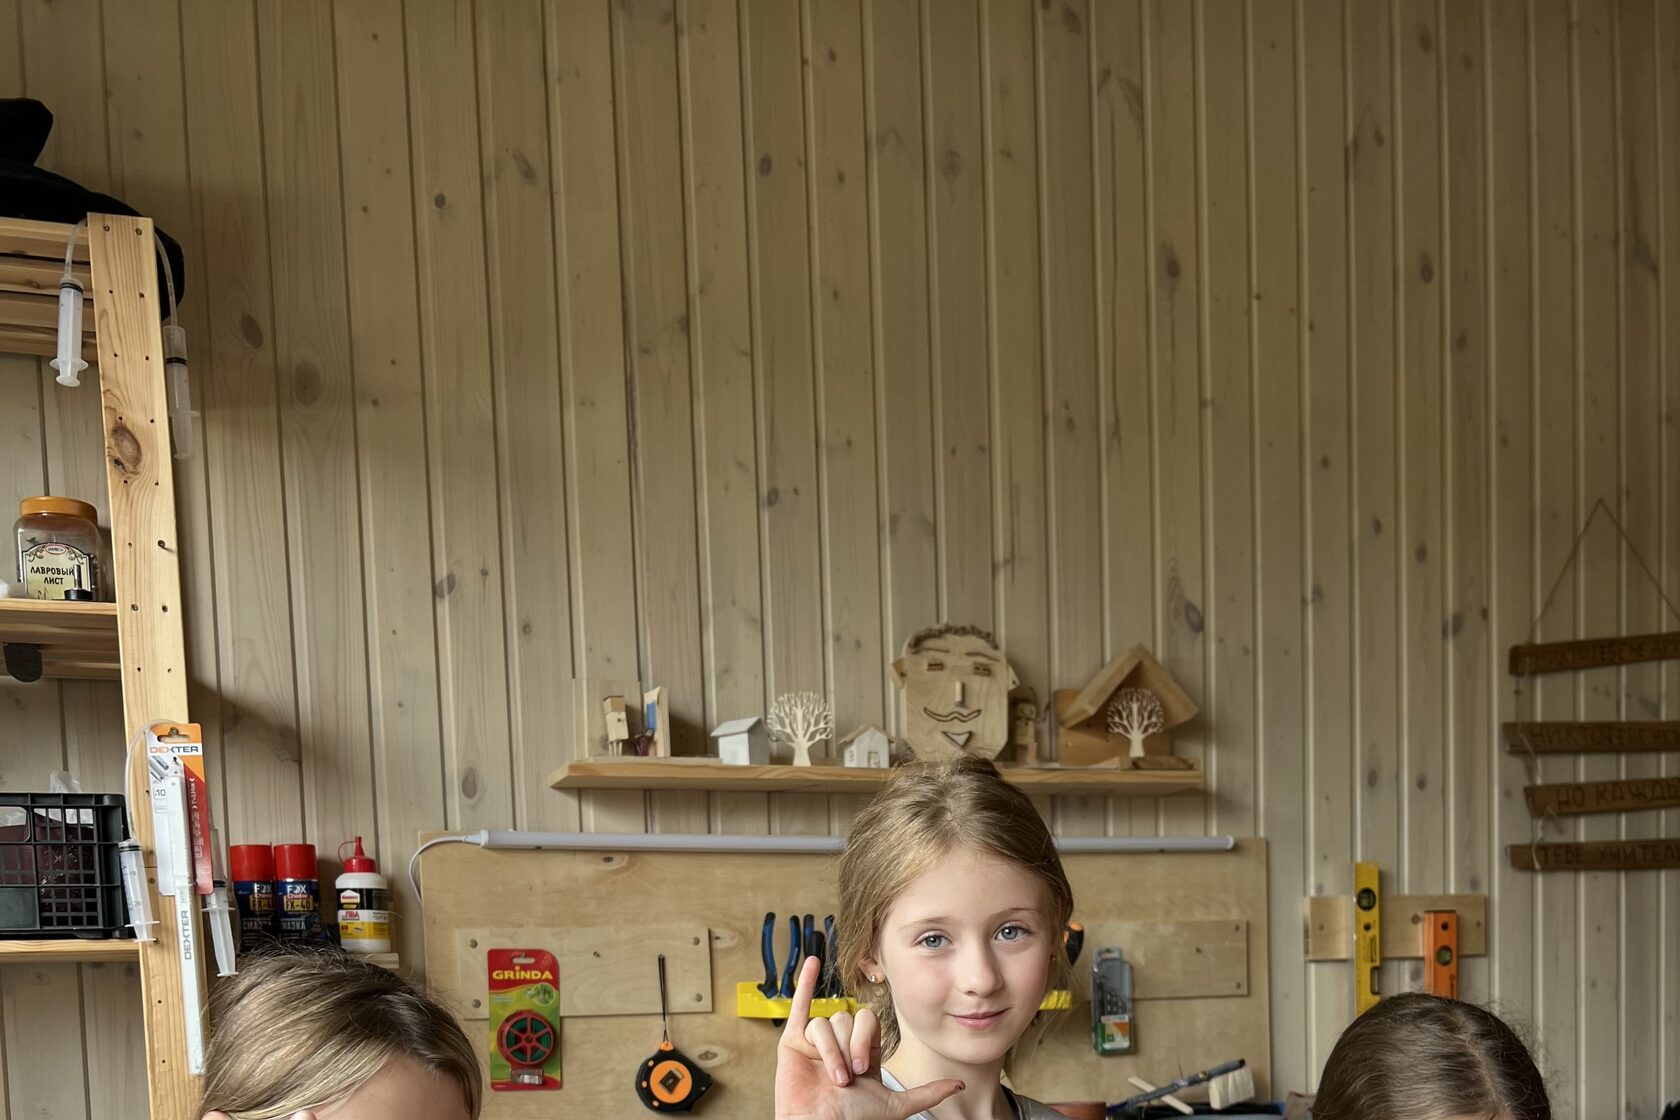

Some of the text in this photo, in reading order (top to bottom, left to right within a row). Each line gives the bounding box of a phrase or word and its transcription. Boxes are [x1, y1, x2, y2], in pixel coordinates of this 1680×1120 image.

[30, 566, 74, 576] ЛАВРОВЫЙ
[44, 577, 64, 585] ЛИСТ
[150, 745, 199, 754] DEXTER
[1555, 785, 1584, 811] НО
[286, 900, 311, 909] FX-40
[243, 921, 271, 931] СМАЗ
[180, 909, 192, 961] DEXTER
